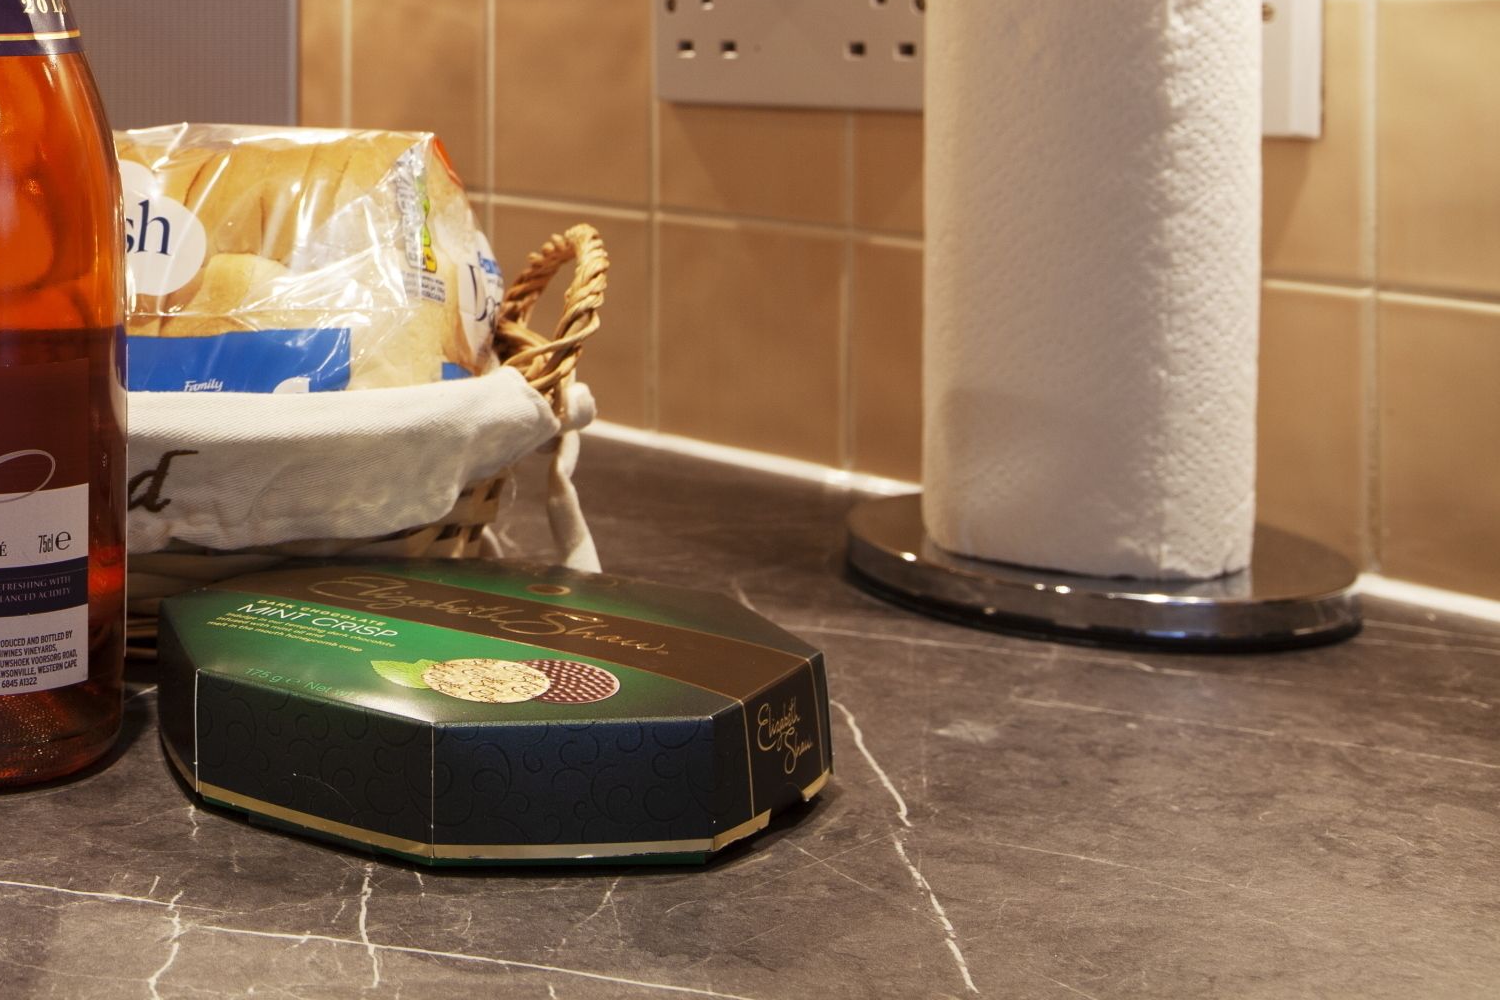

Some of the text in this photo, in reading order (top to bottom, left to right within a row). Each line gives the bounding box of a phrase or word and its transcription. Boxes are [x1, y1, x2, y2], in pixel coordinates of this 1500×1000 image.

[184, 379, 224, 392] Family
[38, 534, 53, 553] 75cl
[50, 576, 71, 584] WITH
[38, 588, 71, 599] ACIDITY
[256, 599, 388, 626] DARK CHOCOLATE
[236, 604, 398, 637] MINT CRISP
[27, 636, 40, 645] AND
[40, 632, 64, 644] BOTTLED
[65, 630, 73, 639] BY
[23, 644, 57, 656] VINEYARDS,
[31, 653, 61, 664] VOORSORG
[37, 662, 64, 674] WESTERN
[64, 659, 77, 668] CAPE
[2, 679, 18, 688] 6845
[244, 668, 272, 678] 175
[304, 681, 333, 693] Net
